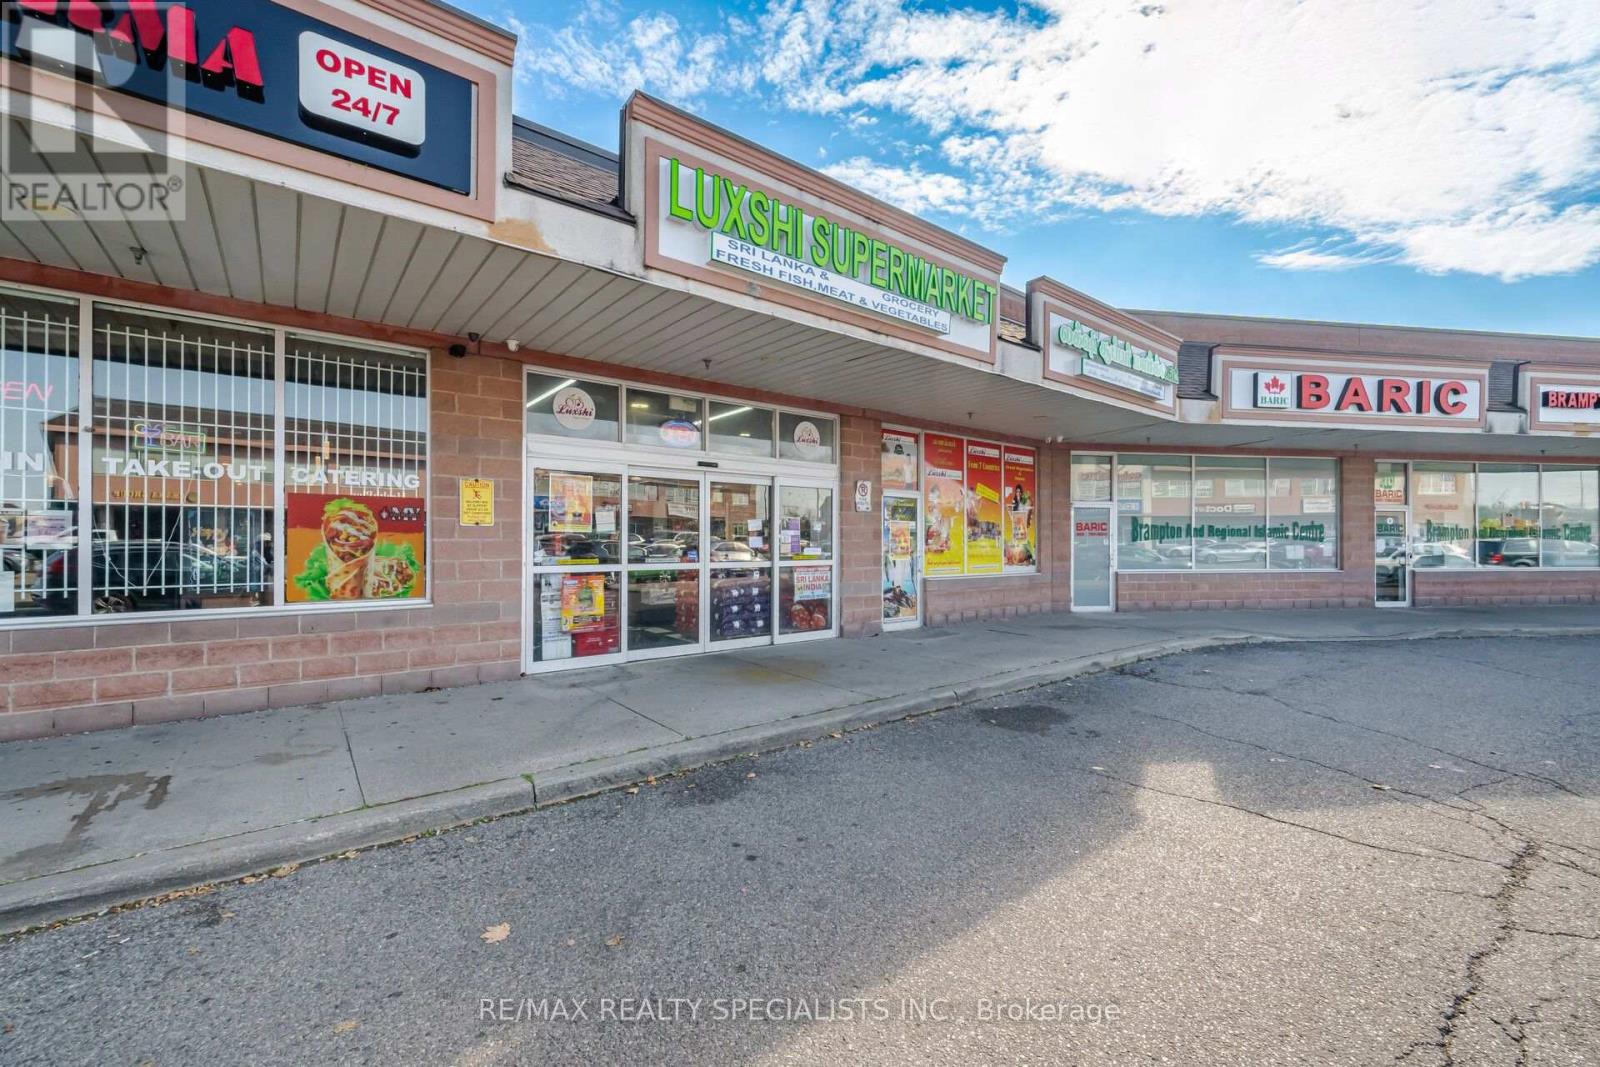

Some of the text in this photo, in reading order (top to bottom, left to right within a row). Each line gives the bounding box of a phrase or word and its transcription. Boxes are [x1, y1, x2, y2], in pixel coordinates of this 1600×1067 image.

[315, 49, 412, 99] OPEN
[331, 89, 400, 125] 24/7
[669, 158, 998, 325] LUXSHI SUPERMARKET
[727, 239, 830, 281] SRI LANKA &
[716, 249, 773, 274] FRESH
[859, 296, 868, 306] &
[872, 300, 949, 332] VEGETABLES
[881, 292, 939, 318] GROCERY
[1260, 396, 1289, 405] BARIC
[1298, 374, 1468, 415] BARIC
[1546, 391, 1600, 409] BRAMP
[556, 404, 594, 417] Luxshi
[102, 457, 266, 481] TAKE-OUT
[291, 466, 420, 489] CATERING
[1376, 489, 1402, 498] BARIC
[1076, 522, 1108, 532] BARIC
[1131, 516, 1325, 544] Brampton And Regional Islamic Centre
[1377, 524, 1403, 533] BARIC
[1427, 519, 1469, 545] Brampton
